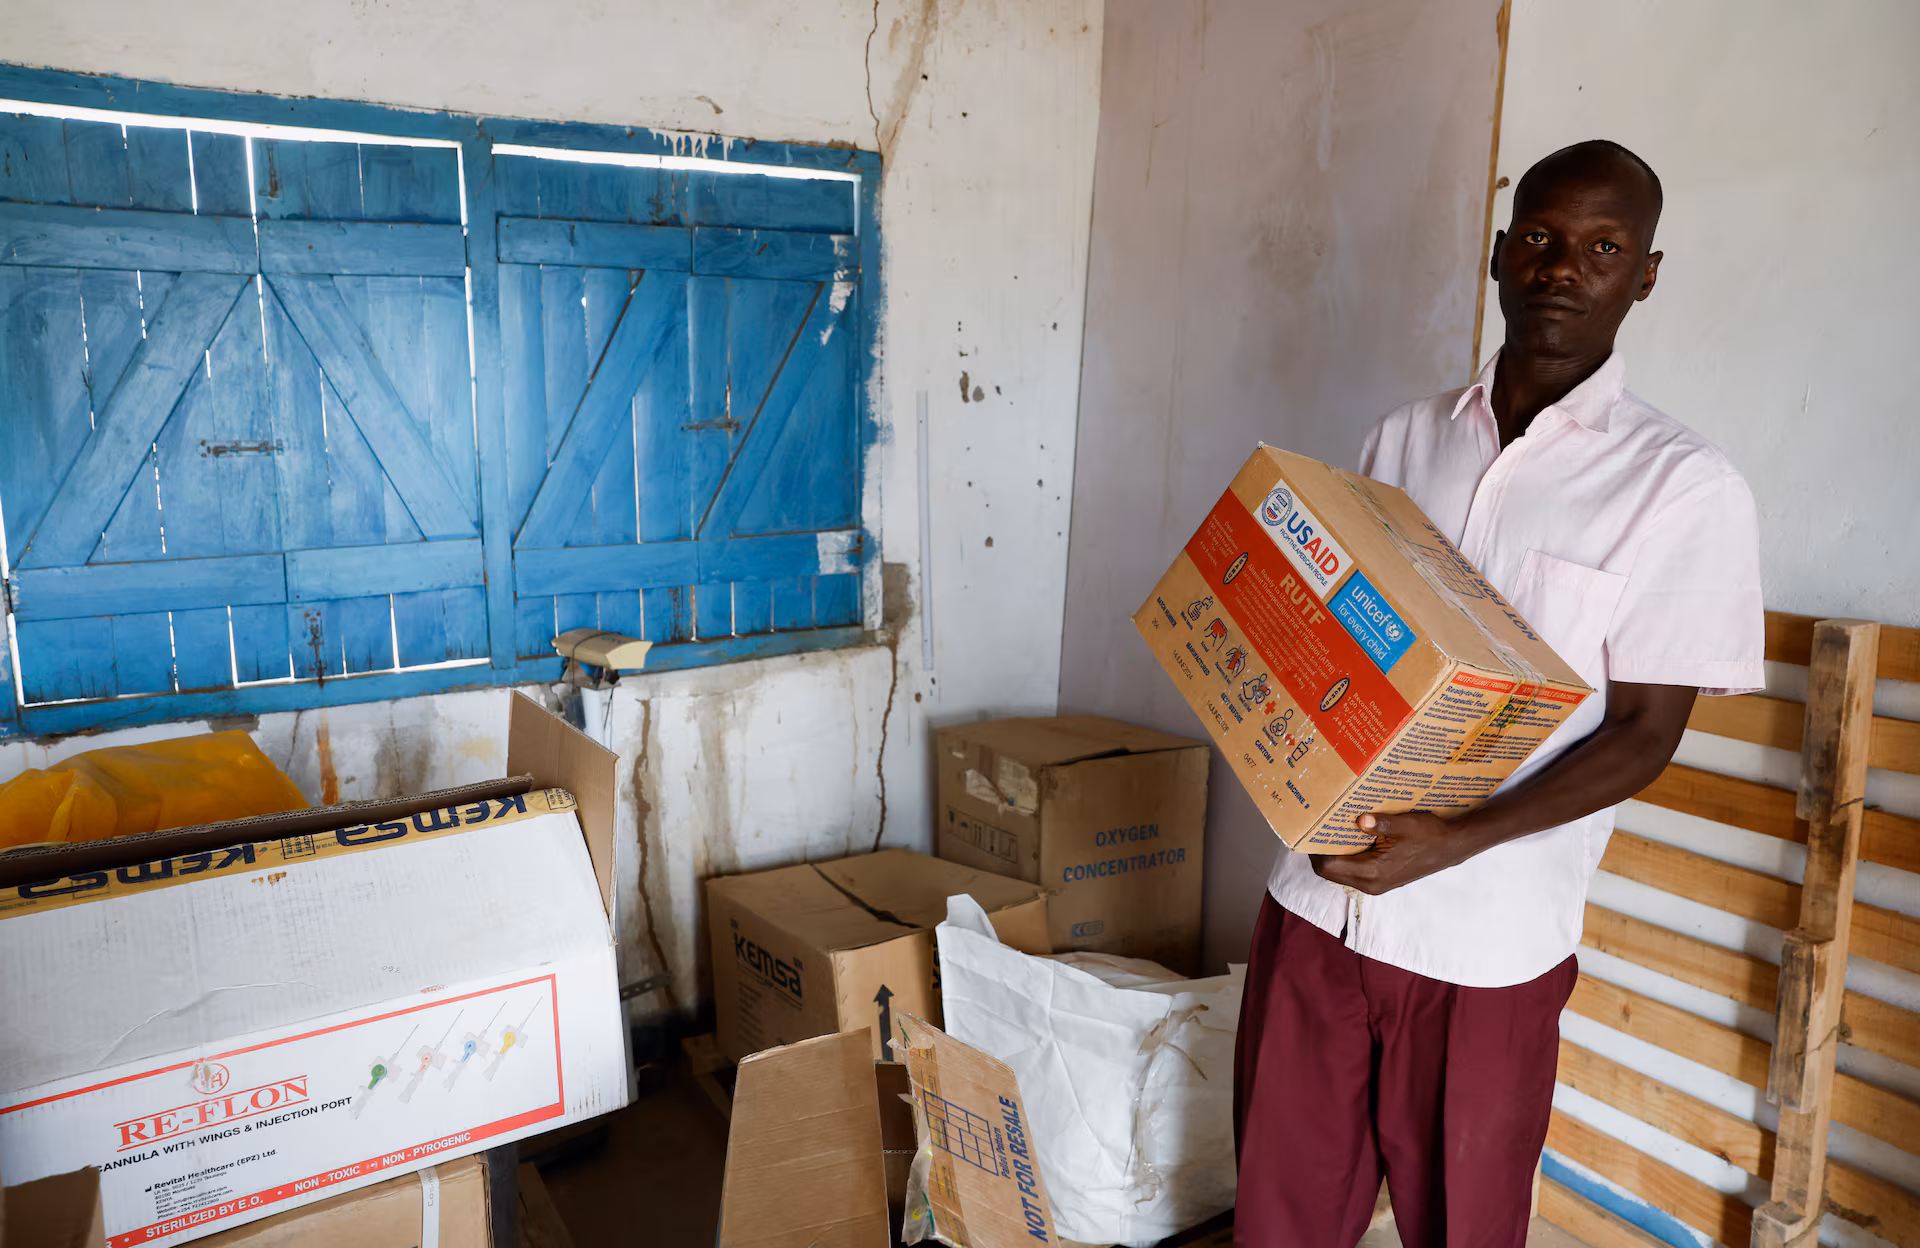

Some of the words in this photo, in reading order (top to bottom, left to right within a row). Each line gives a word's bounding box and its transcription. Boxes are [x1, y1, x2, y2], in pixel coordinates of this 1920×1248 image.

[1286, 512, 1339, 577] USAID
[1422, 522, 1476, 575] RESALE
[1295, 547, 1314, 570] AMERICAN
[1312, 568, 1327, 586] PEOPLE
[1280, 574, 1324, 628] RUTF
[1352, 582, 1390, 628] unicef
[1474, 578, 1507, 607] FOR
[1247, 563, 1263, 584] Aliment
[1318, 653, 1335, 674] (ATPE)
[1260, 568, 1275, 588] Ready
[1274, 585, 1280, 594] to
[1287, 603, 1315, 639] Therapeutic
[1315, 637, 1329, 655] Food
[1502, 609, 1539, 641] NOT
[1338, 602, 1350, 618] for
[1346, 615, 1368, 642] every
[1366, 636, 1386, 660] child
[1185, 641, 1210, 676] MANUFACTURED
[1228, 703, 1242, 723] BEFORE
[1369, 700, 1382, 716] Dose
[1440, 694, 1474, 706] Therapeutic
[1474, 700, 1490, 708] Food
[1254, 738, 1271, 761] CARTON
[1358, 784, 1392, 793] Instruction
[1374, 766, 1400, 775] Storage
[1400, 770, 1434, 778] Instructions
[1286, 778, 1304, 805] MACHINE
[1342, 802, 1374, 810] Contains
[1095, 824, 1160, 847] OXYGEN
[1063, 848, 1186, 883] CONCENTRATOR
[118, 1078, 309, 1147] RE-FLON
[162, 1139, 196, 1156] WITH
[198, 1128, 241, 1145] WINGS
[244, 1124, 252, 1132] &
[256, 1106, 318, 1129] INJECTION
[321, 1096, 352, 1113] PORT
[998, 1095, 1029, 1160] RESALE
[994, 1127, 1005, 1156] Pattern
[146, 1208, 217, 1238] STERILIZED
[219, 1203, 236, 1217] BY
[238, 1196, 264, 1210] E.O.
[294, 1178, 320, 1194] NON
[328, 1166, 361, 1184] TOXIC
[382, 1152, 405, 1166] NON
[413, 1131, 472, 1157] PYROGENIC
[154, 1176, 186, 1190] Revital
[188, 1161, 235, 1180] Healthcare
[236, 1154, 260, 1166] (EPZ)
[262, 1149, 278, 1158] Ltd.
[998, 1154, 1012, 1180] Pallet
[1013, 1156, 1039, 1199] FOR
[156, 1196, 172, 1204] KENYA
[172, 1185, 196, 1194] Mombasa
[158, 1212, 176, 1220] Phone:
[1020, 1196, 1049, 1243] NOT
